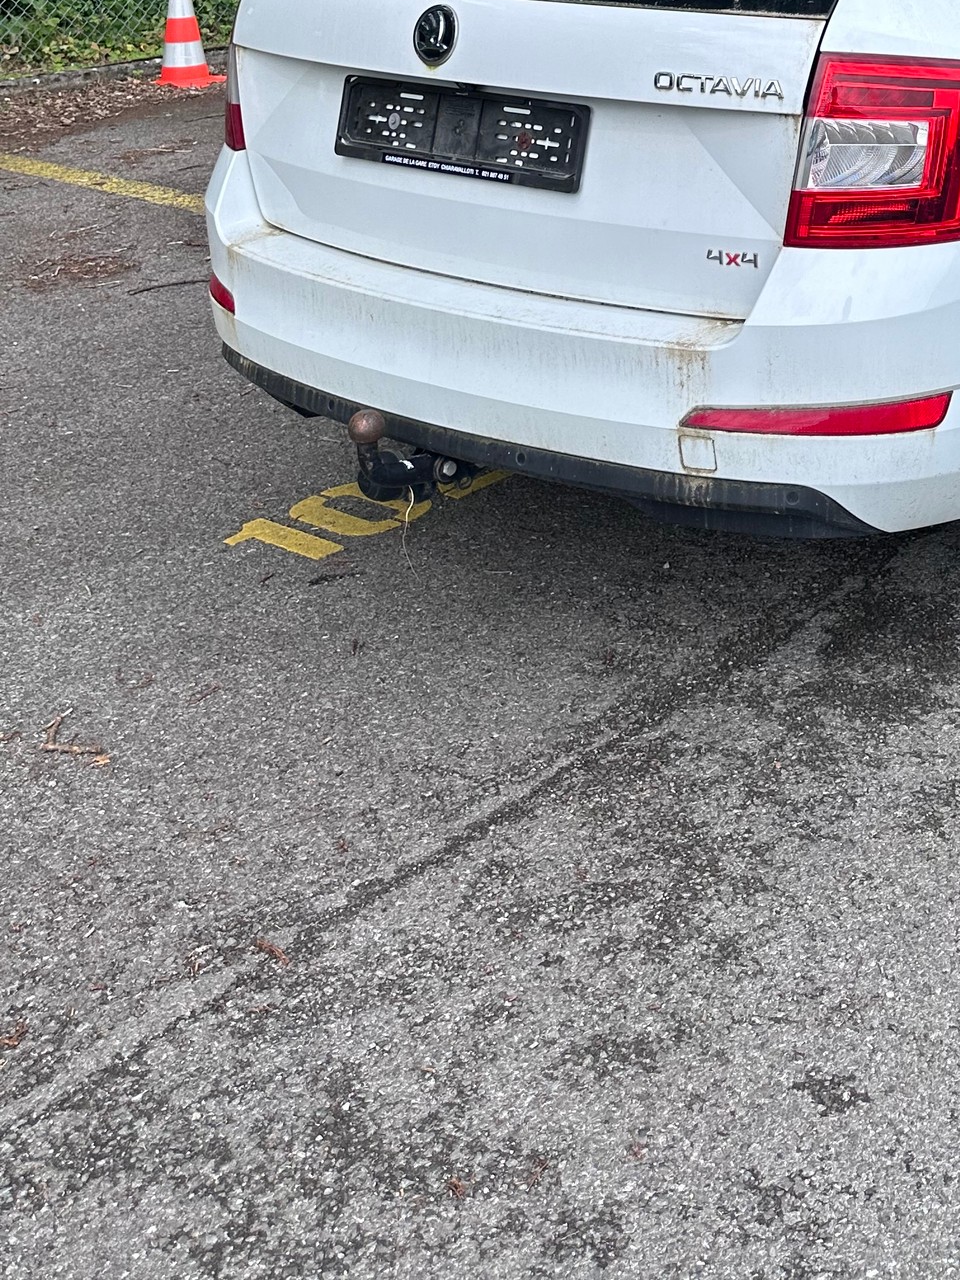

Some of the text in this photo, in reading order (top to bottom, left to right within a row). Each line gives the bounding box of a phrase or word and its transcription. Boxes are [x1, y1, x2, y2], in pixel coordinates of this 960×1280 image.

[653, 71, 784, 100] OCTAVIA
[385, 155, 402, 163] GARAGE
[403, 157, 409, 165] DE
[415, 159, 427, 168] GARE
[706, 249, 758, 269] 4x4
